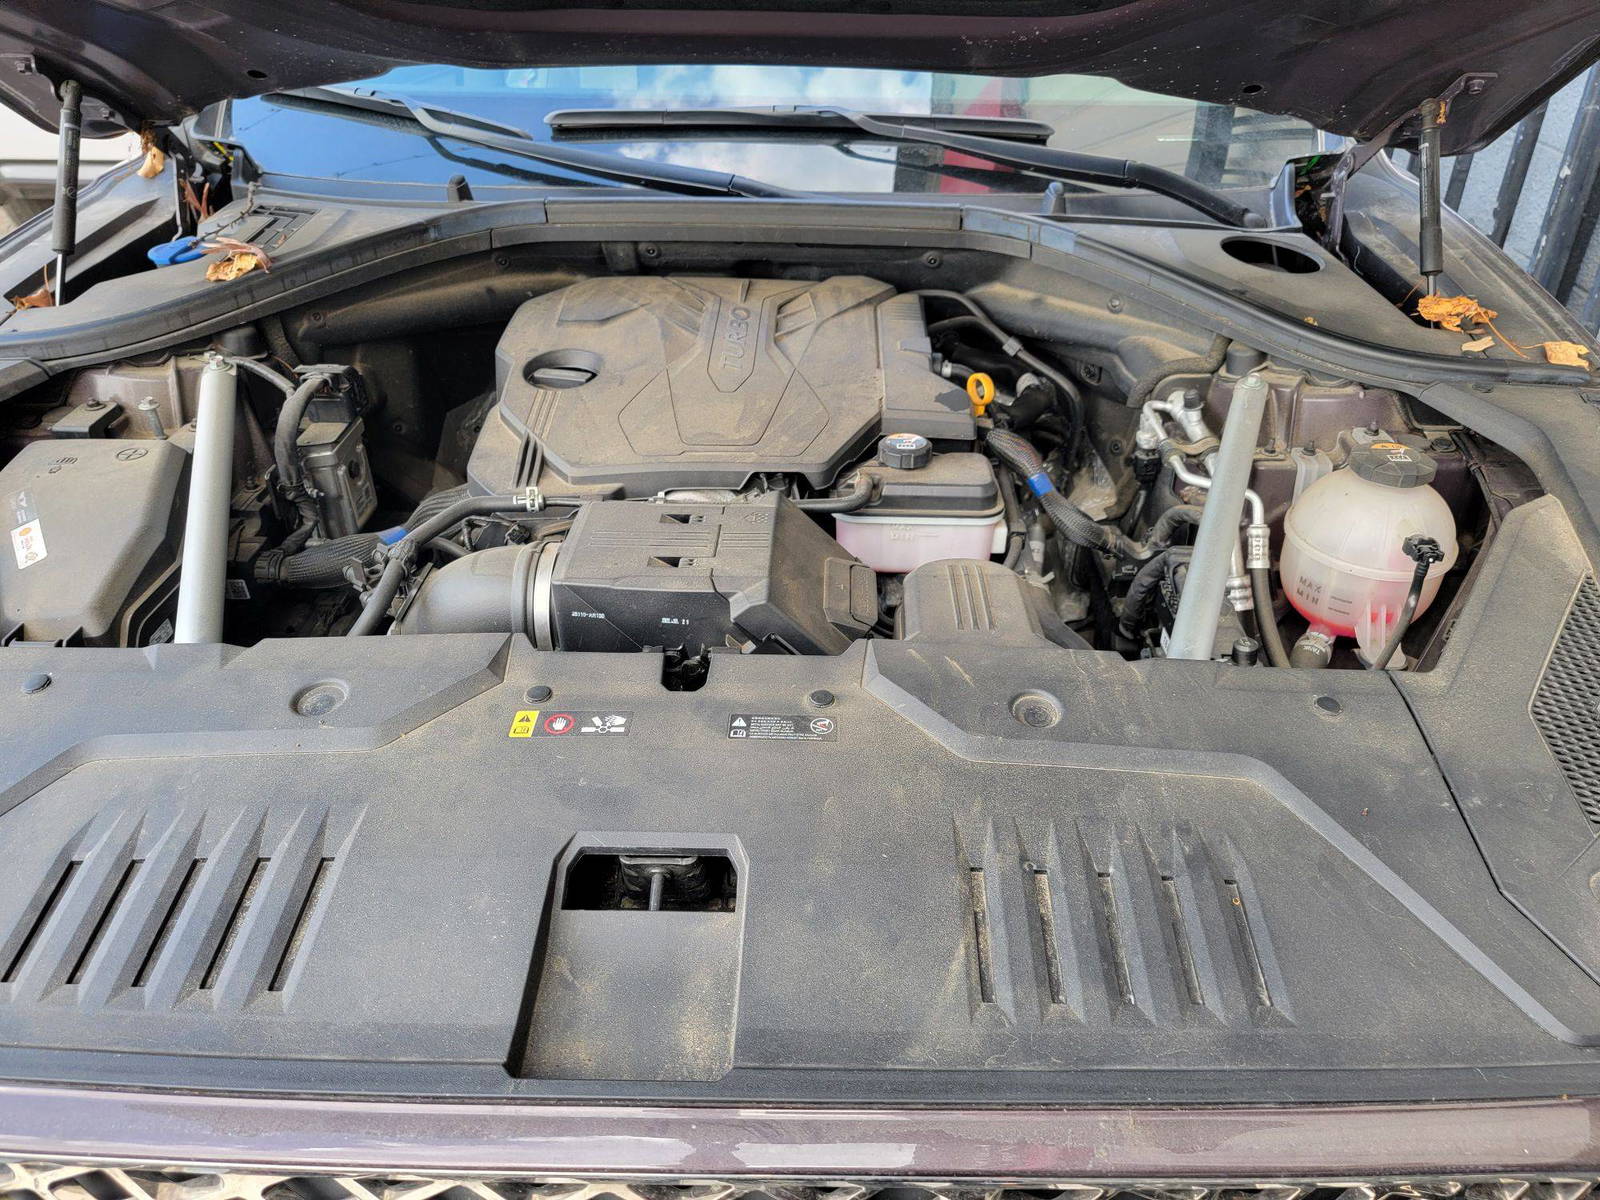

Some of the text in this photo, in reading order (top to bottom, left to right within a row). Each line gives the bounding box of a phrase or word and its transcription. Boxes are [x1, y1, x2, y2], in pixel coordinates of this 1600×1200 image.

[721, 307, 751, 368] TURBO
[1299, 576, 1322, 593] MAX
[1297, 588, 1319, 605] MIN
